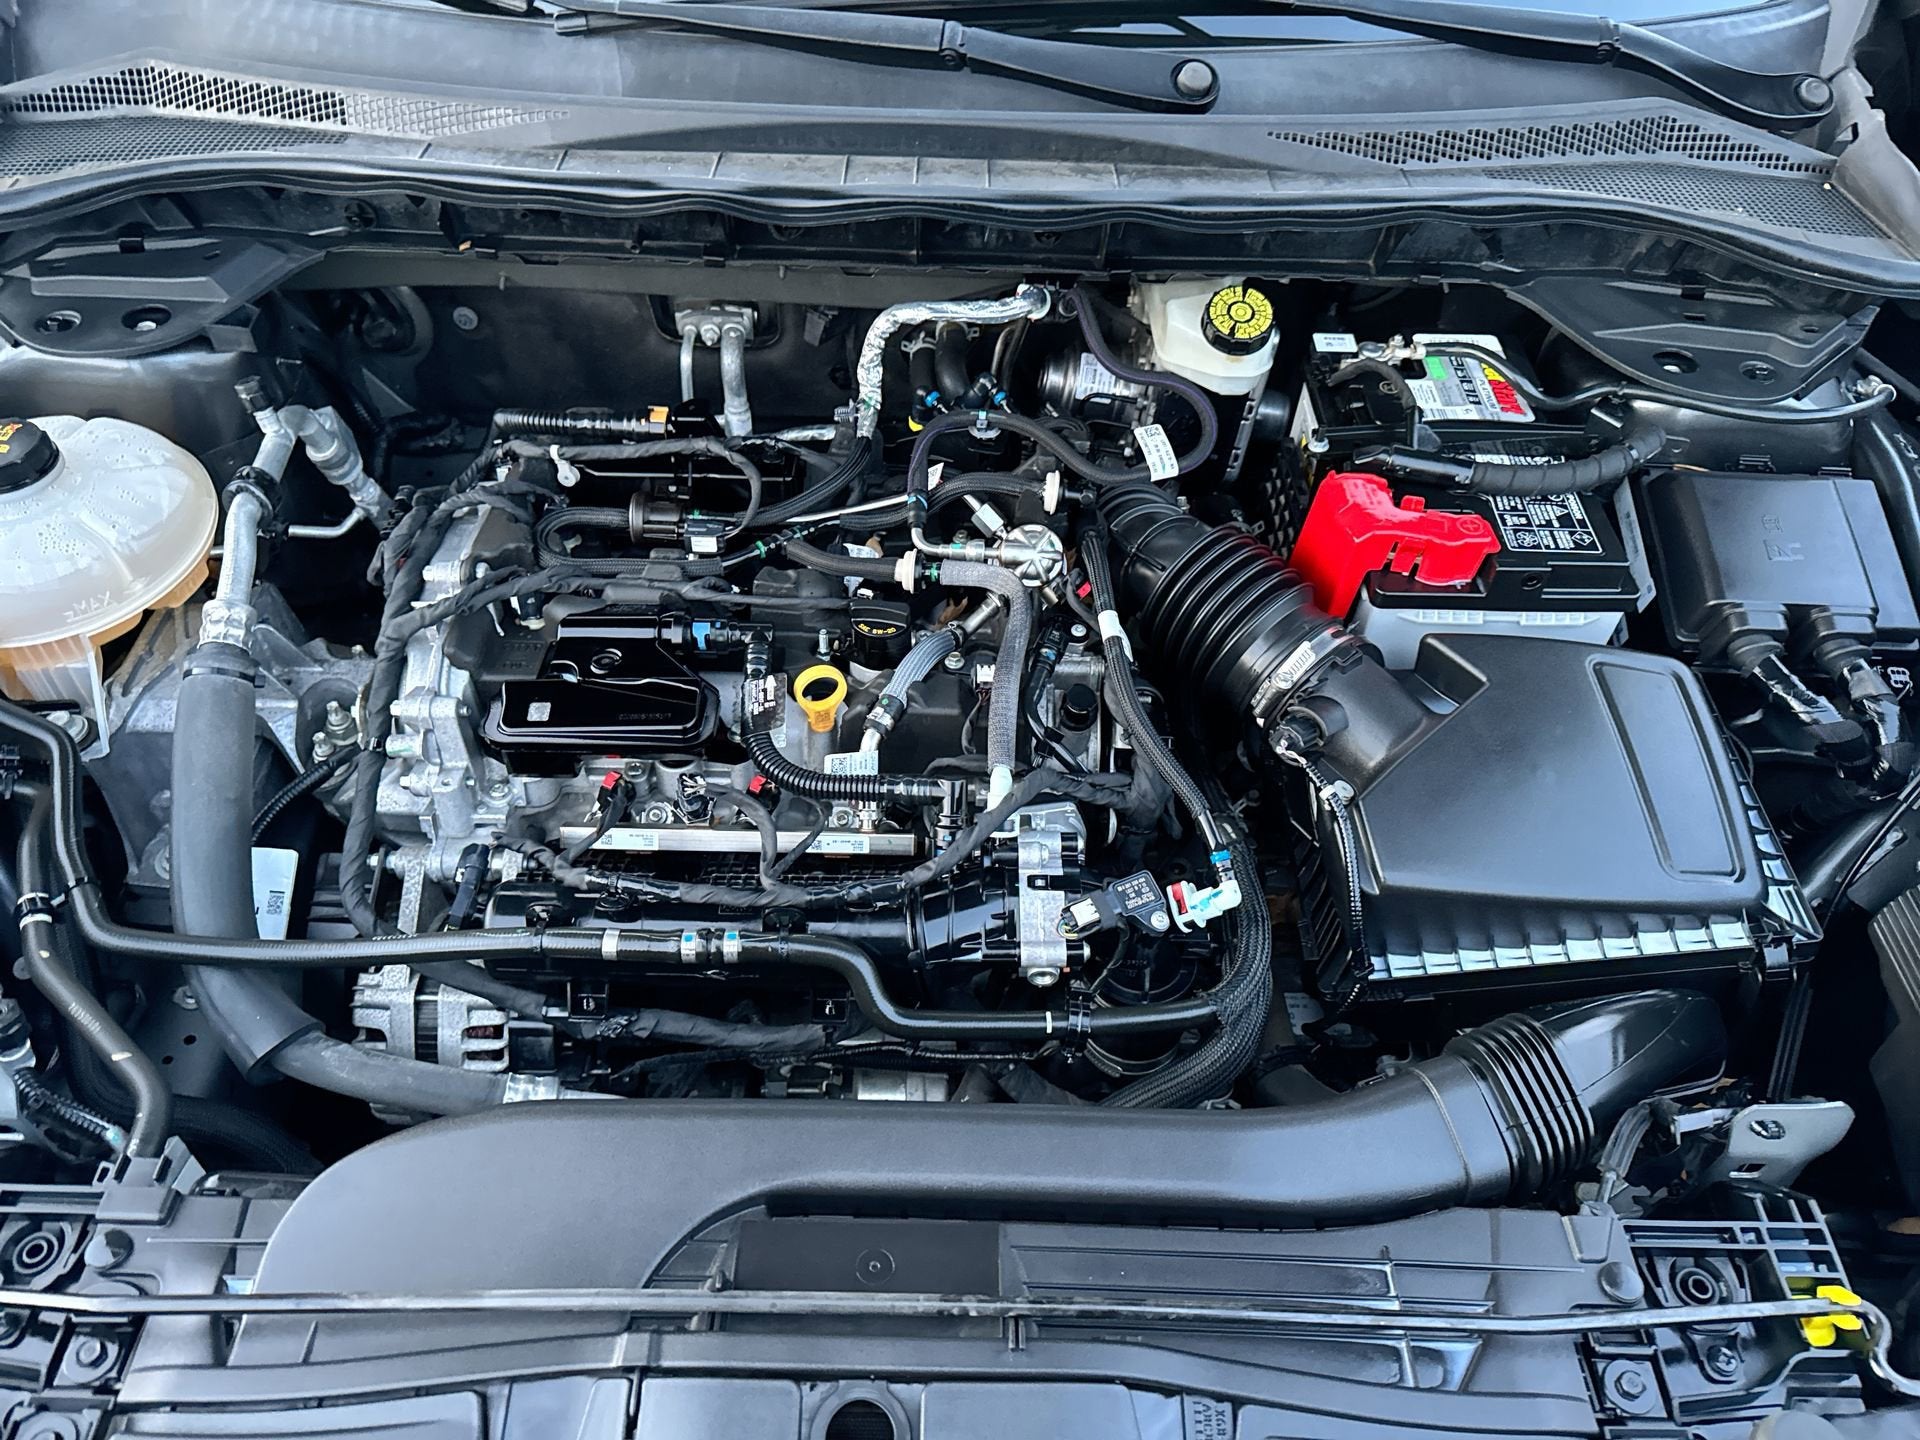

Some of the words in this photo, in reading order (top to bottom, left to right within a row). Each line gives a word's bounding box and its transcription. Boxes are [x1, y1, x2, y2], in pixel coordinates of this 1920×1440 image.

[1479, 379, 1498, 410] PLATINUM
[72, 591, 112, 615] MAX
[858, 623, 870, 632] SAE
